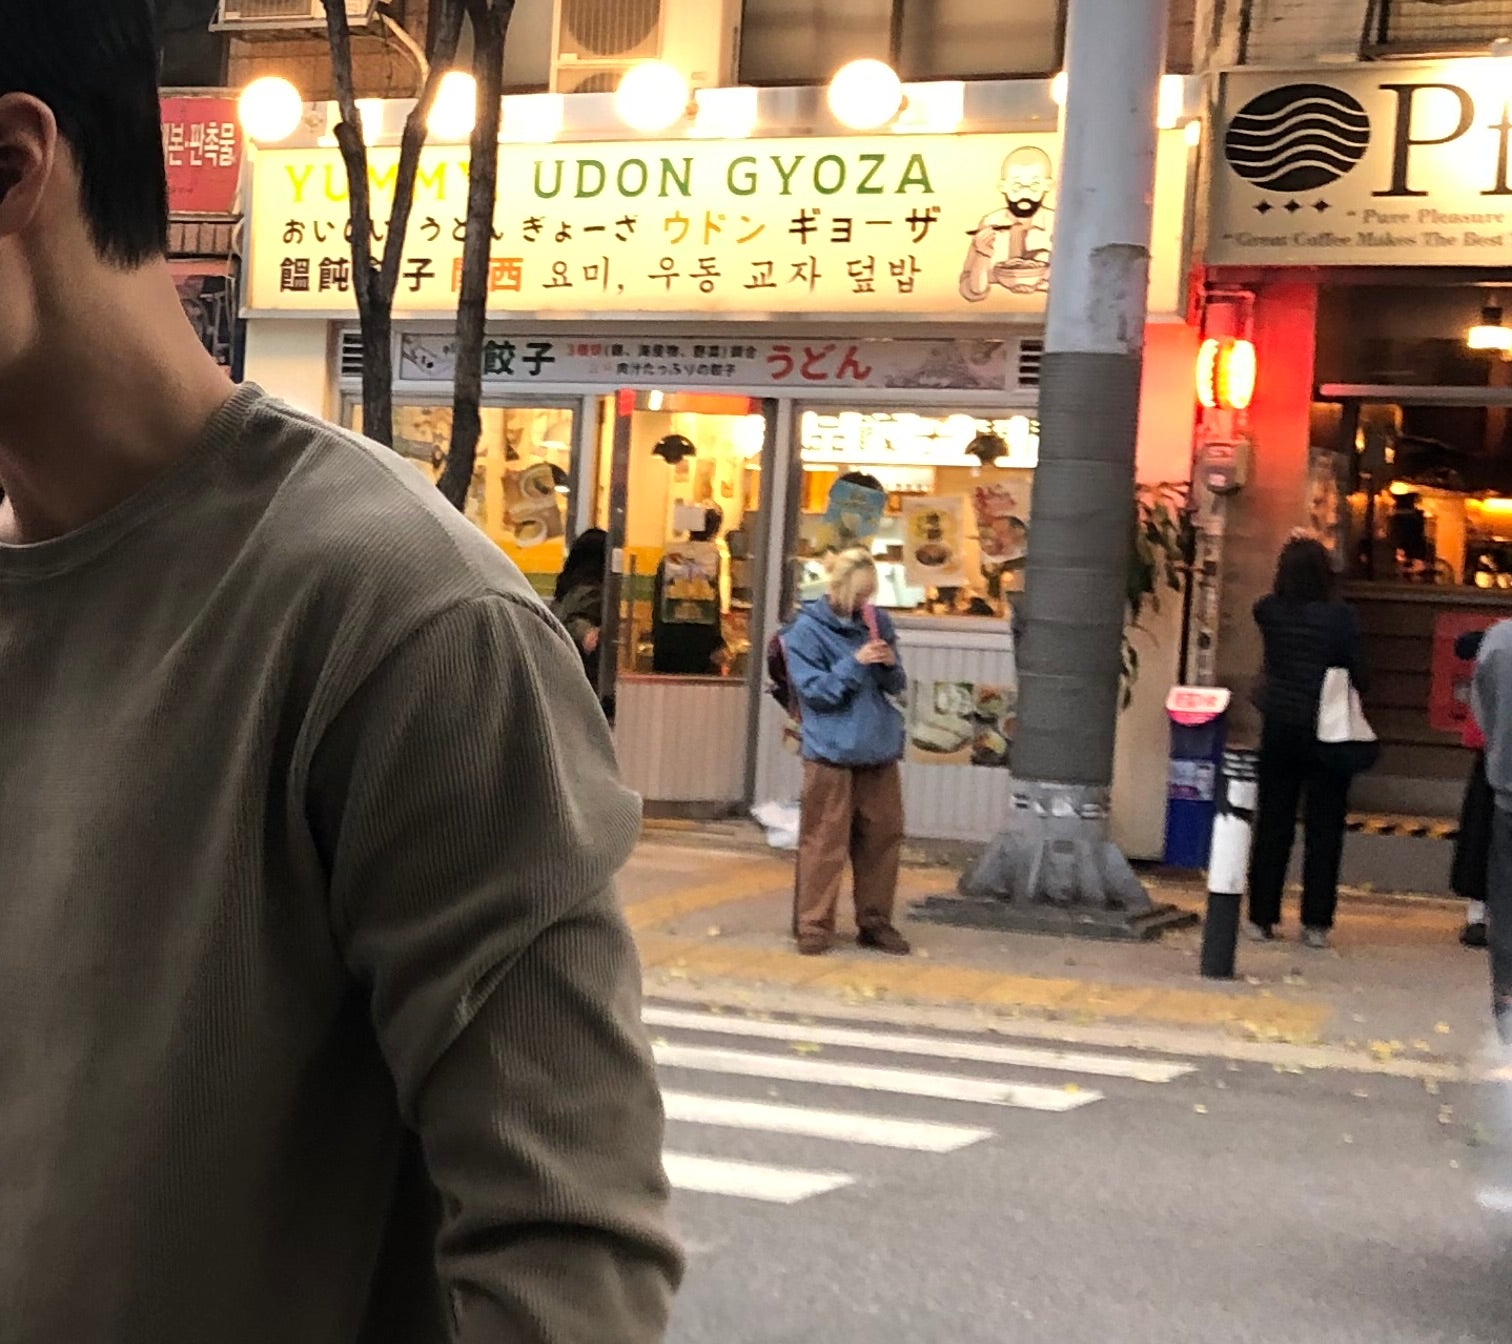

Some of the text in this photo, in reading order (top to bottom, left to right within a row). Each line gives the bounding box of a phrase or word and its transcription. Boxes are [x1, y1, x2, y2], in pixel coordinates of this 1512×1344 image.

[285, 152, 936, 203] YUMM UDON GYOZA
[522, 212, 641, 243] ぎょーざ
[662, 209, 767, 246] ウドン
[787, 205, 943, 246] ギョーザ
[279, 256, 436, 294] 饂飩子
[647, 257, 723, 294] 우동
[742, 256, 823, 293] 교자
[846, 255, 923, 294] 덮밥
[766, 343, 873, 382] うどん
